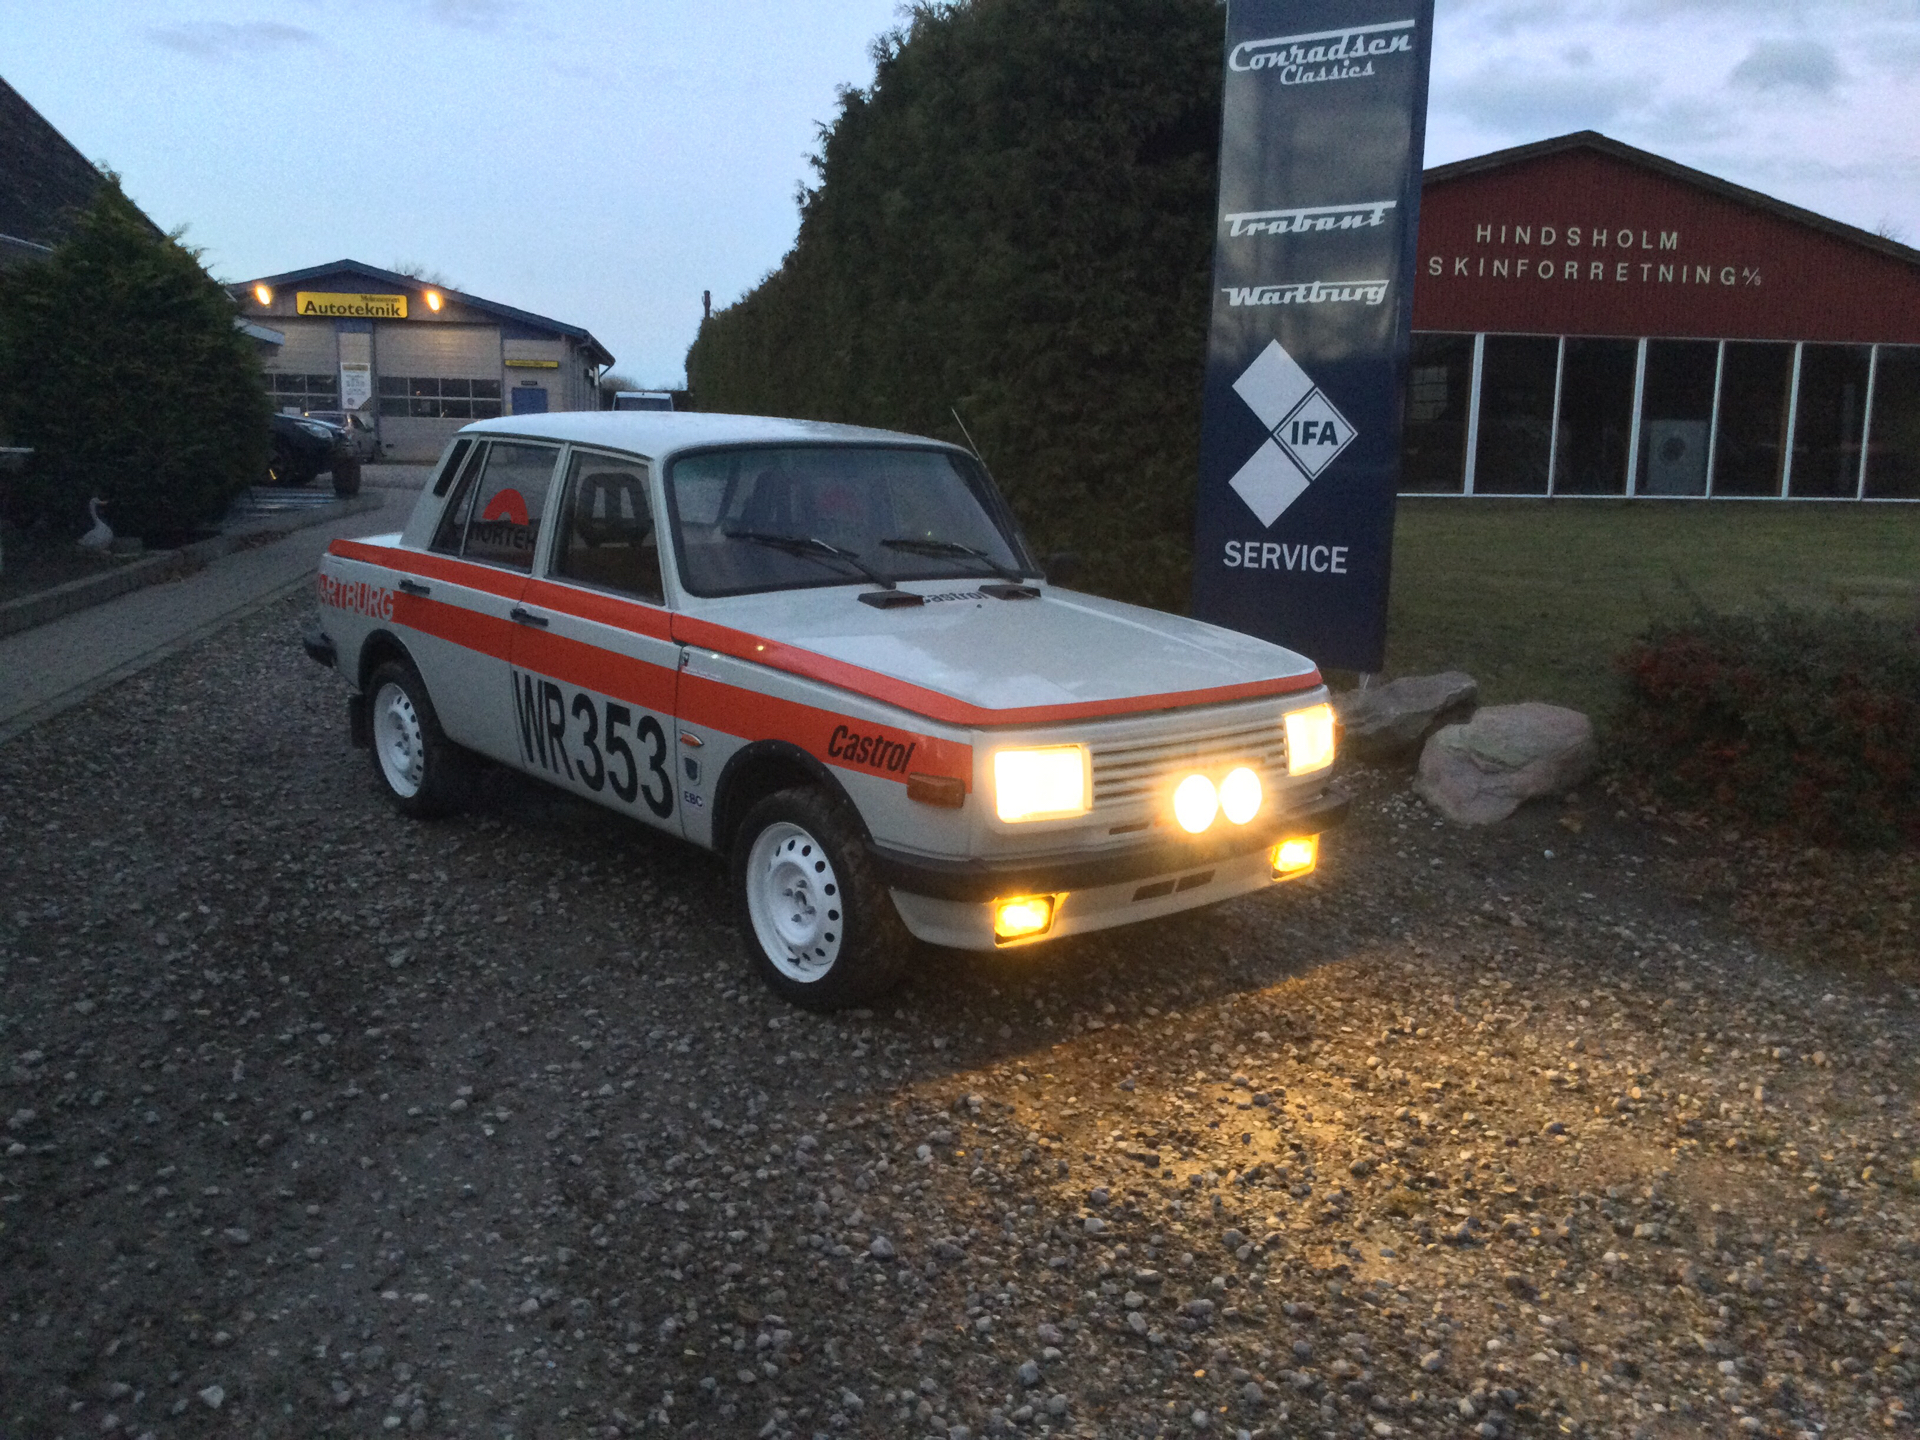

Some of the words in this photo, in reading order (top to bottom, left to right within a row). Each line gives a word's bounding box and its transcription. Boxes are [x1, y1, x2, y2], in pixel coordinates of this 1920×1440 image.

[1228, 19, 1415, 72] Conradsen
[1280, 60, 1375, 85] Classics
[1224, 200, 1397, 237] Trabant
[1476, 224, 1678, 250] HINDSHOLM
[1428, 256, 1736, 285] SKINFORRETNING
[1221, 279, 1389, 306] Wartburg
[304, 300, 401, 317] Autoteknik
[1290, 421, 1338, 446] IFA
[1223, 540, 1349, 574] SERVICE
[513, 670, 674, 819] WR353
[827, 725, 916, 774] Castrol
[684, 790, 703, 807] EBC
